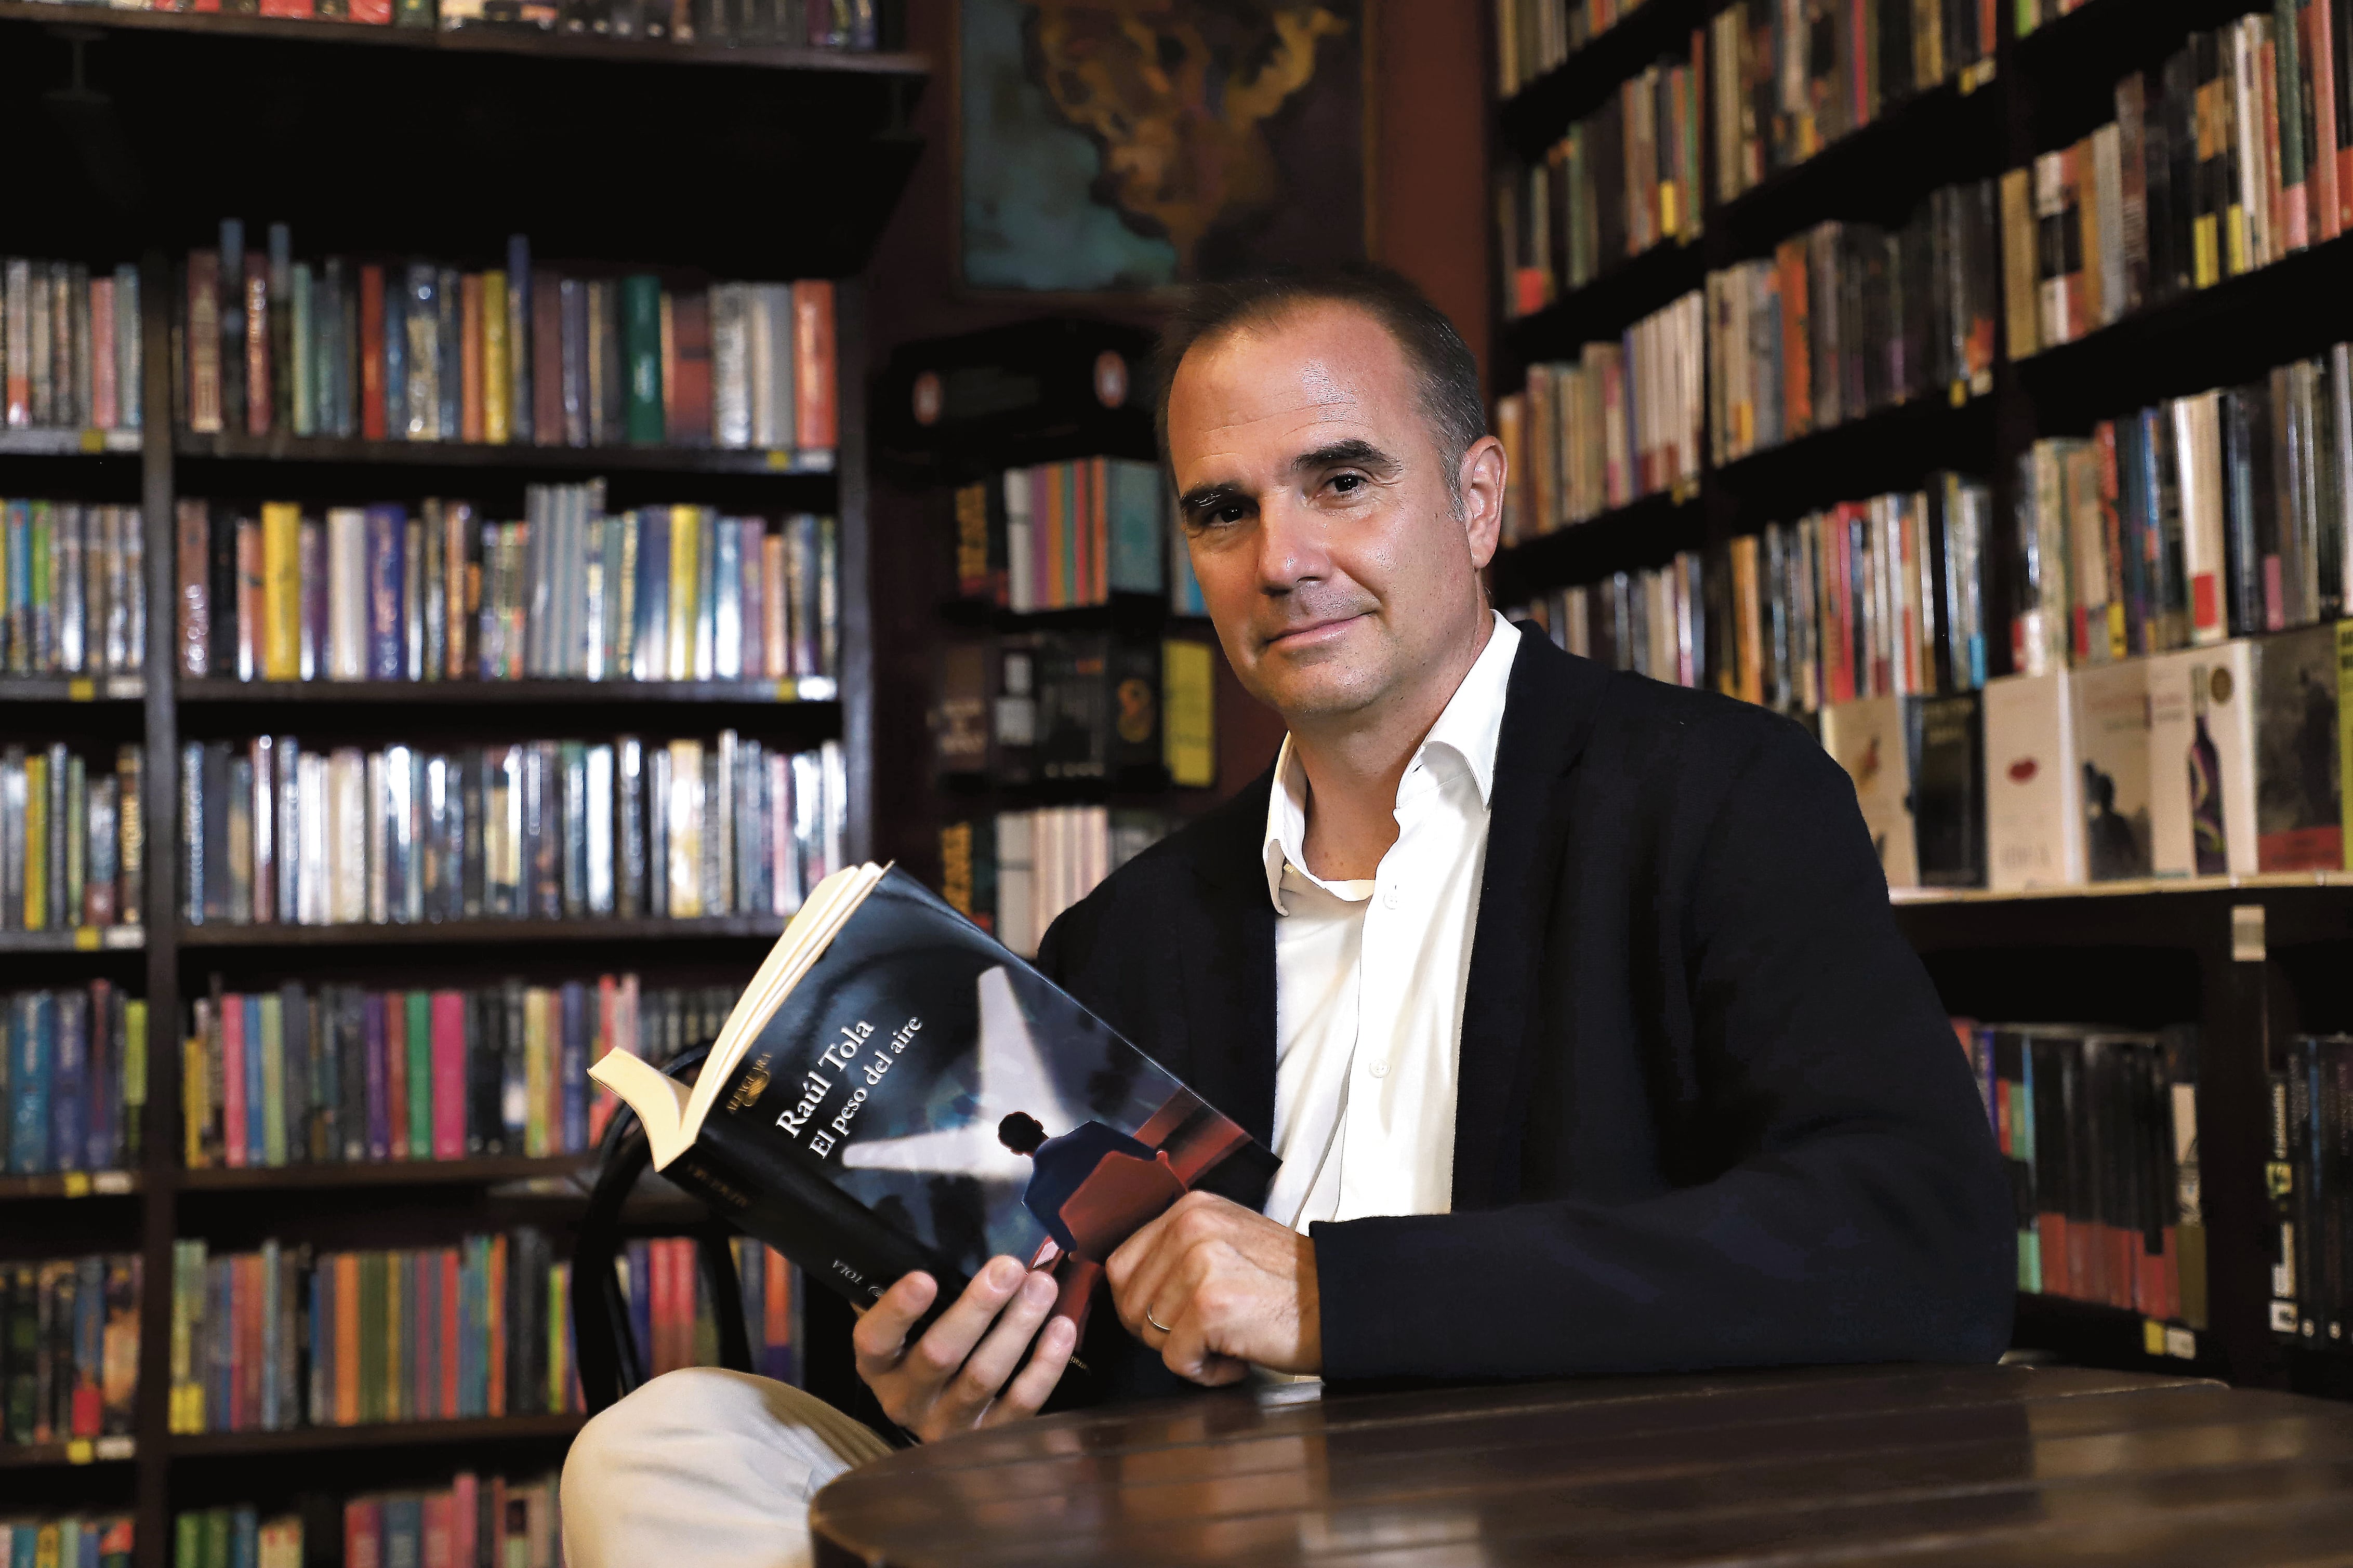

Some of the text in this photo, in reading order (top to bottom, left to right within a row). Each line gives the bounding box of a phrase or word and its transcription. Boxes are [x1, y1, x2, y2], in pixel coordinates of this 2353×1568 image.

[776, 1020, 875, 1138] Raúl Tola
[809, 1016, 922, 1159] El peso del aire
